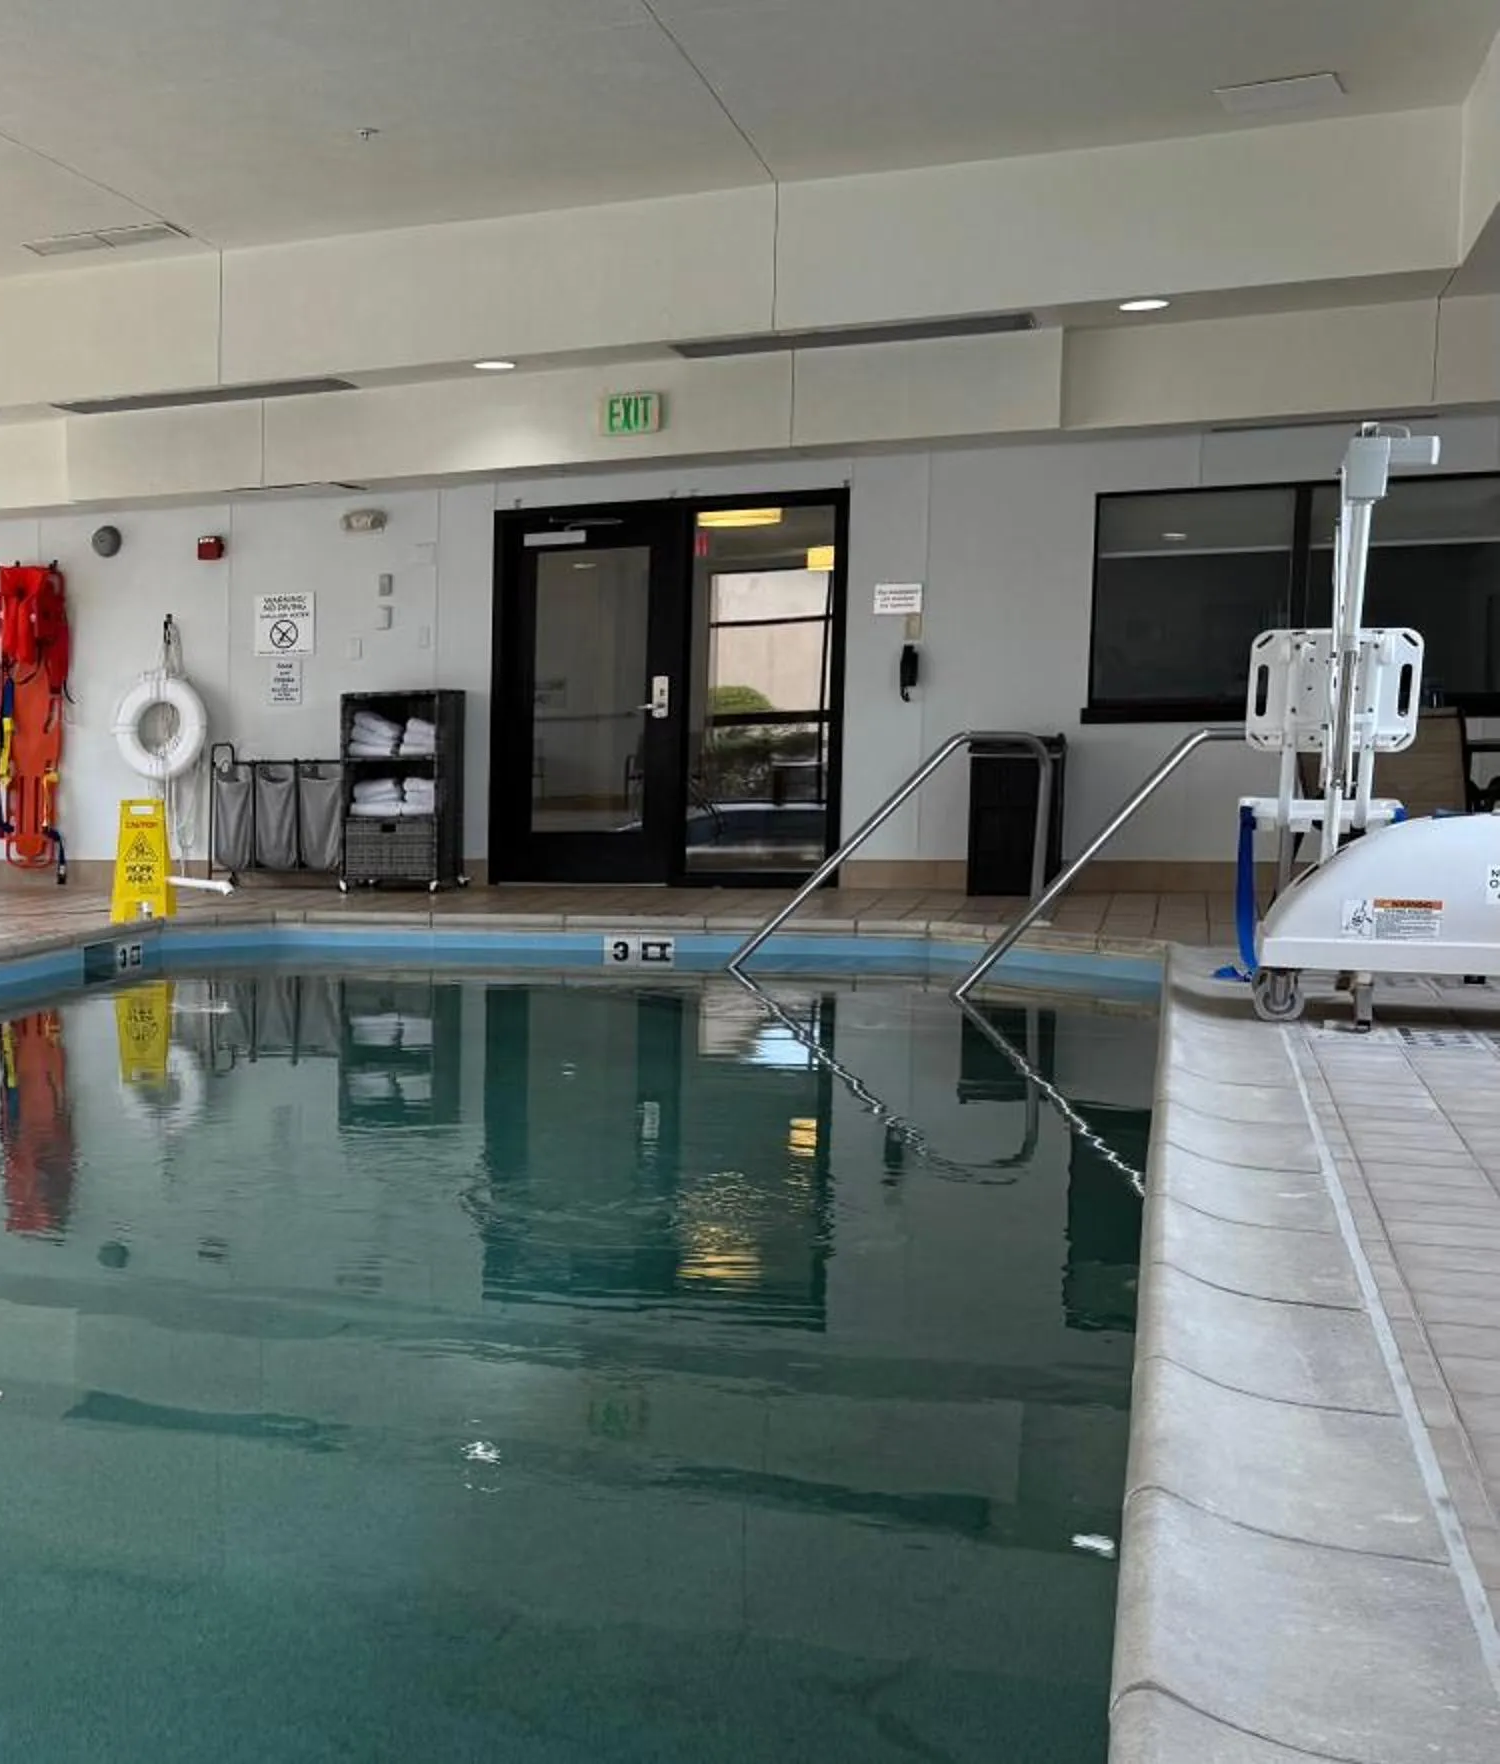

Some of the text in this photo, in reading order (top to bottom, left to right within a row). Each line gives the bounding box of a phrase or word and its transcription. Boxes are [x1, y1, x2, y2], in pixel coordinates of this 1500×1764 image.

[609, 397, 652, 432] EXIT
[125, 864, 155, 873] WORK
[126, 874, 153, 884] AREA
[612, 940, 629, 962] 3
